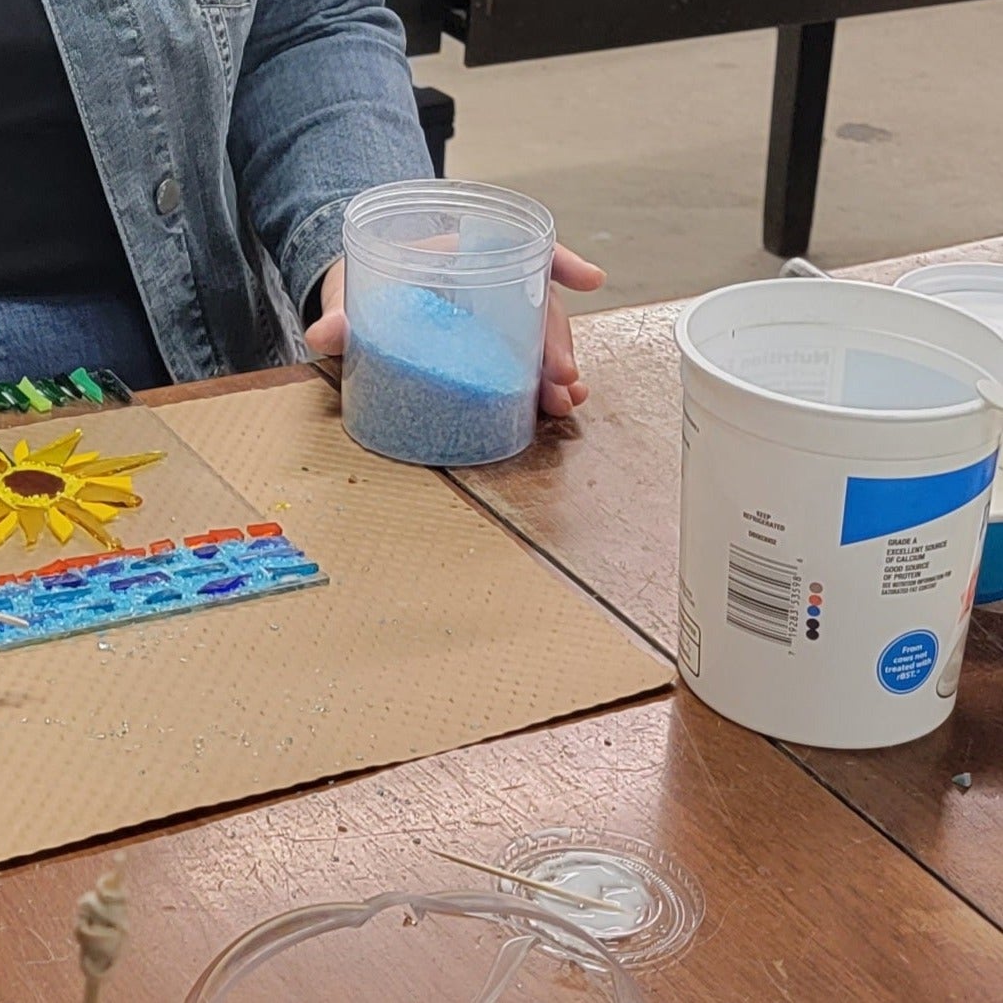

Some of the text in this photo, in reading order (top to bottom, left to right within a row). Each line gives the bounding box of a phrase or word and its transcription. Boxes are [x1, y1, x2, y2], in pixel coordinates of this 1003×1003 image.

[756, 510, 771, 520] KEEP
[742, 511, 786, 532] REFRIGERATED
[888, 537, 917, 546] GRADE A
[886, 540, 948, 556] EXCELLENT SOURCE
[885, 553, 926, 564] OF CALCIUM
[884, 561, 930, 573] GOOD SOURCE
[893, 571, 922, 581] PROTEIN
[788, 609, 799, 637] 19283
[901, 644, 923, 654] From
[893, 651, 928, 664] cows not
[885, 657, 932, 674] treated with
